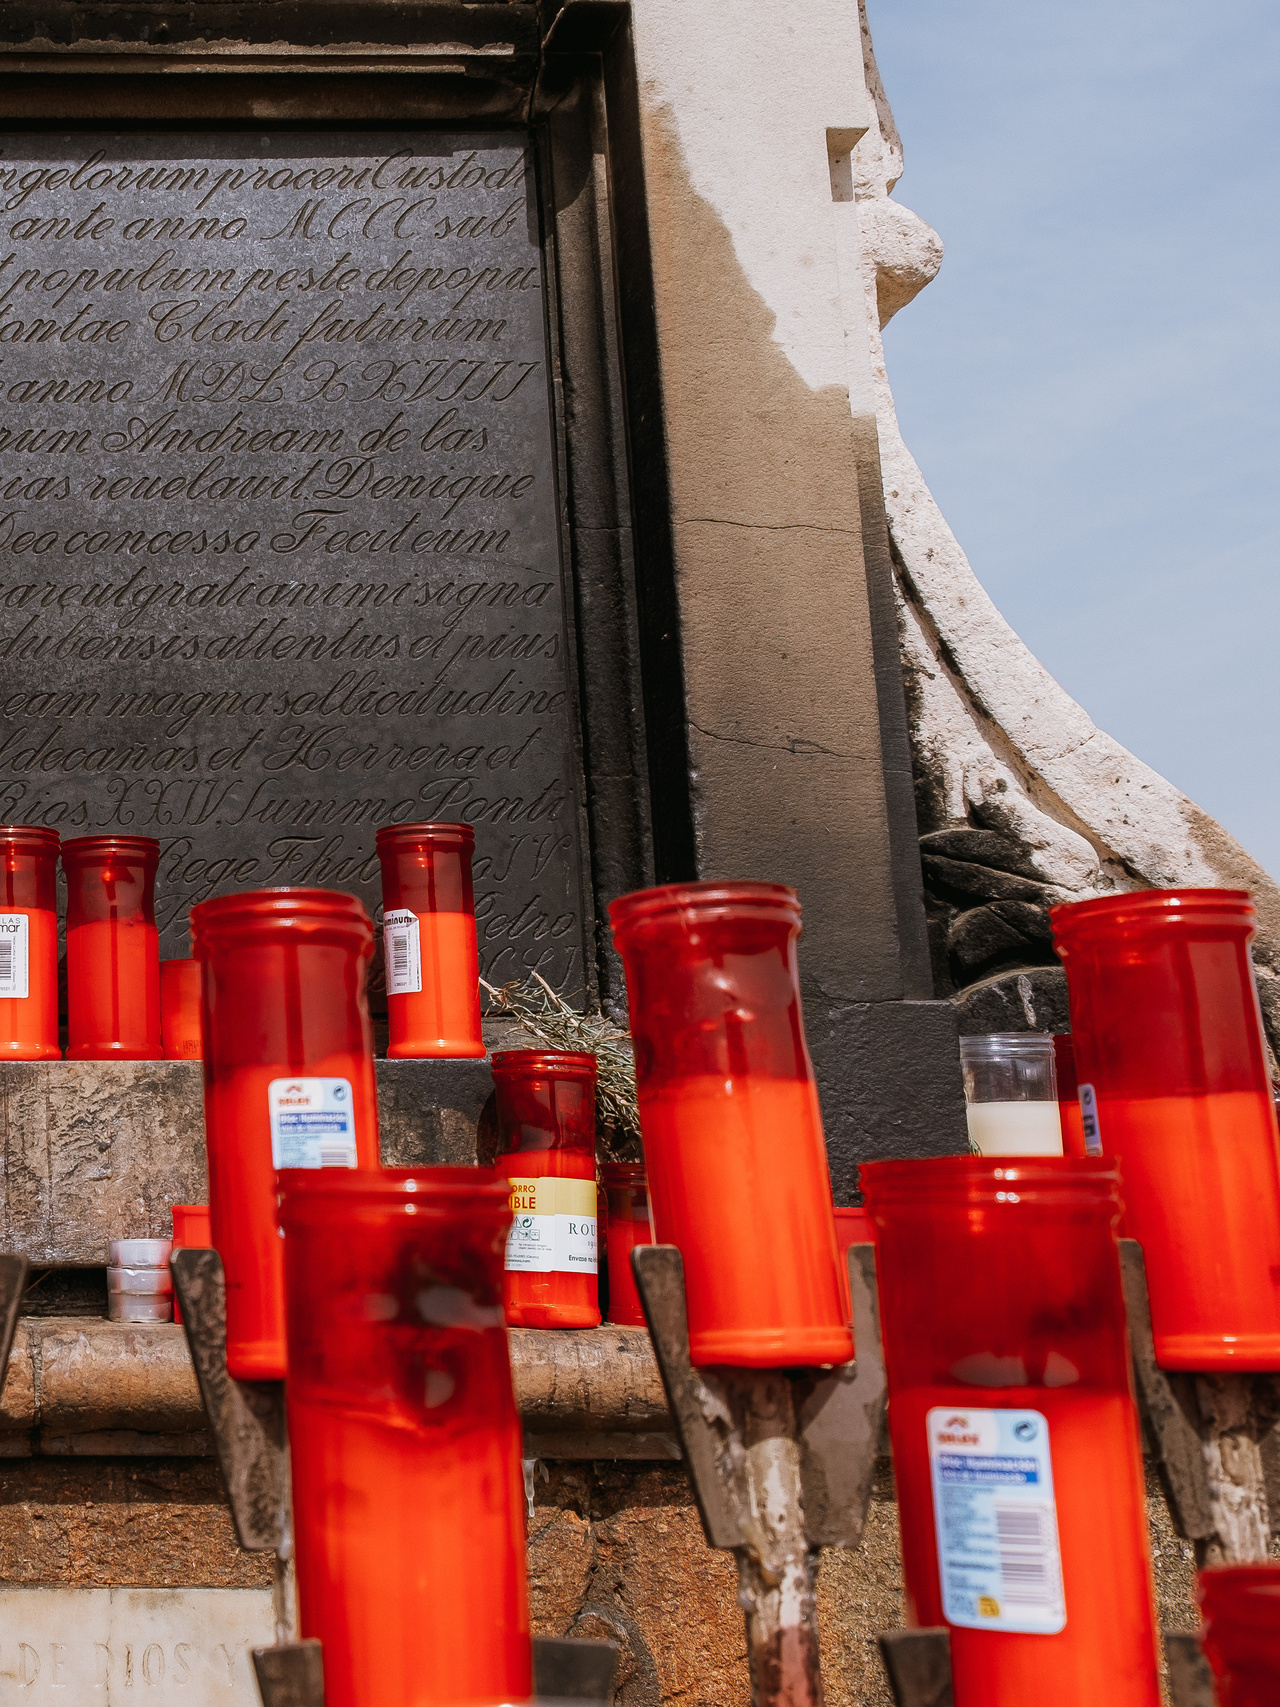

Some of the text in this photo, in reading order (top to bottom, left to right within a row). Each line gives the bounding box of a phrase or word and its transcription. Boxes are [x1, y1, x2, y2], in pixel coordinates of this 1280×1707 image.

[8, 201, 117, 240] ante
[122, 214, 249, 240] anno
[100, 409, 343, 455] Andream
[357, 410, 413, 455] de
[419, 407, 490, 454] las
[93, 1641, 194, 1688] DIOS
